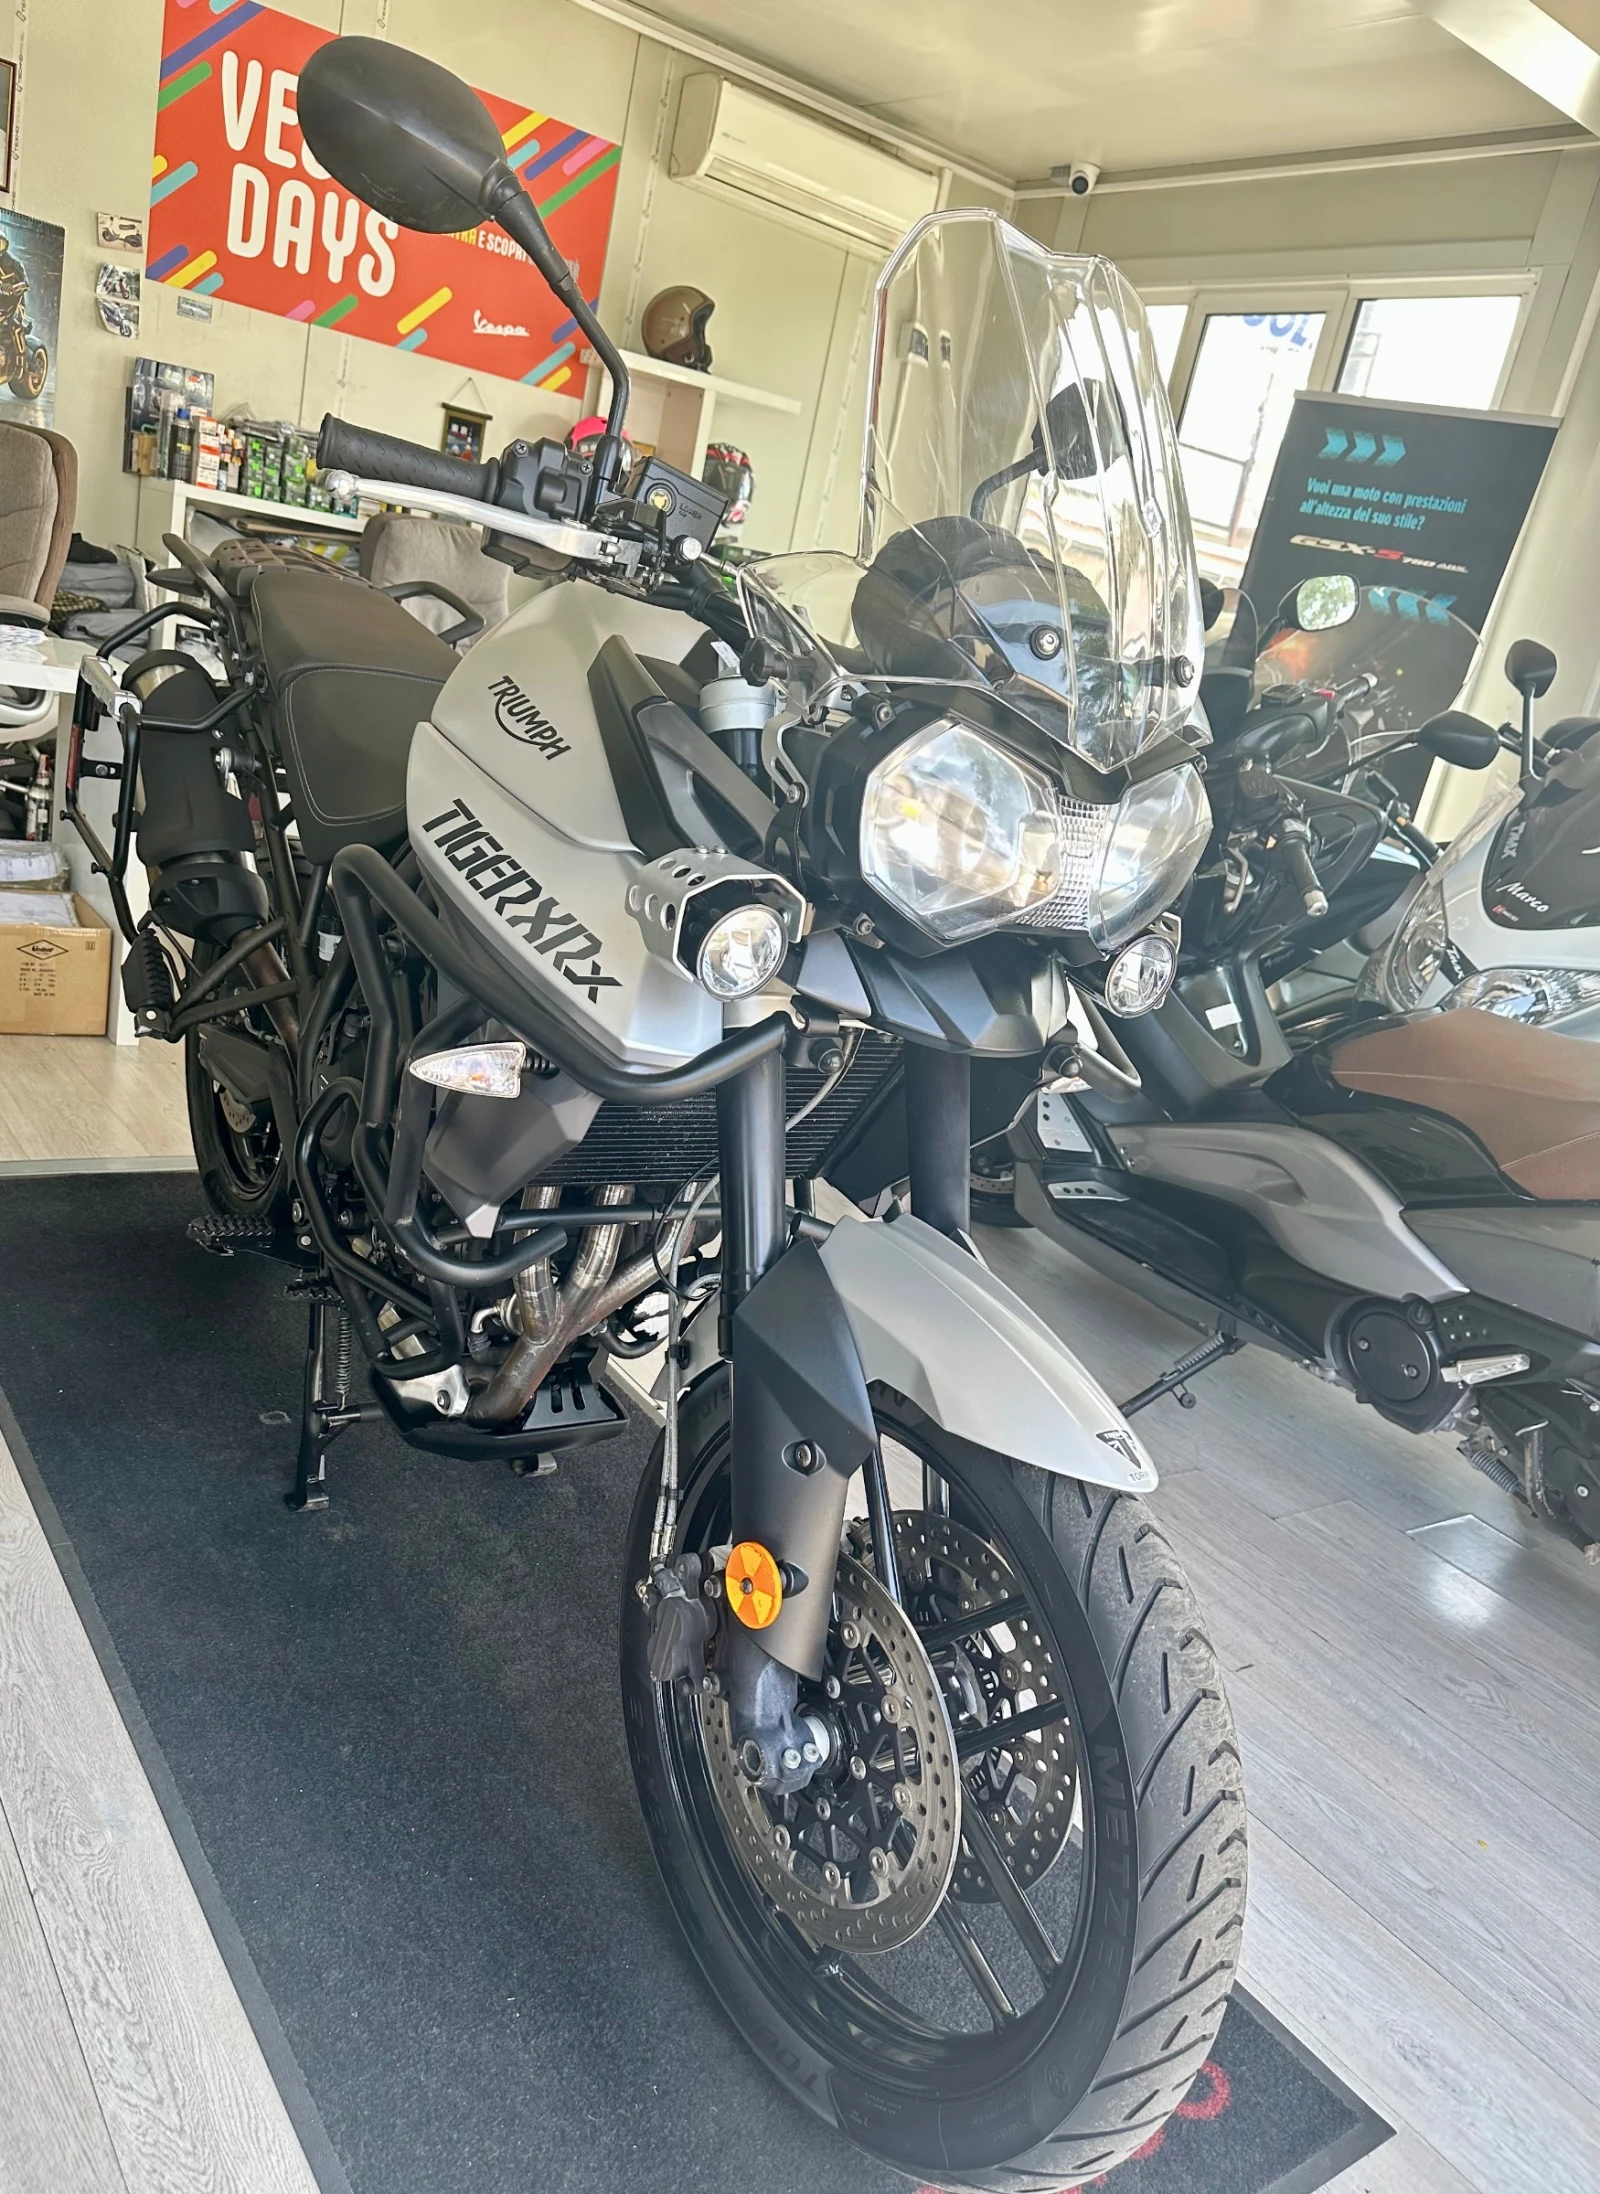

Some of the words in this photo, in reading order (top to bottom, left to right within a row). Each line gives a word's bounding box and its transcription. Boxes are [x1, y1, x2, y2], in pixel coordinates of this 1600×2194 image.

[227, 163, 399, 297] DAYS
[477, 230, 487, 249] E
[473, 309, 530, 337] Vespa
[1307, 477, 1332, 495] Vuoi
[1331, 484, 1352, 497] una
[1353, 487, 1381, 502] moto
[1382, 491, 1402, 504] con
[1403, 492, 1468, 514] prestazioni
[1299, 500, 1352, 519] all'altezza
[1353, 506, 1371, 522] del
[1371, 512, 1392, 526] suo
[1393, 515, 1426, 530] stile?
[488, 674, 572, 761] TRIUMPH
[422, 798, 542, 916] TIGER
[1496, 881, 1550, 913] Marco
